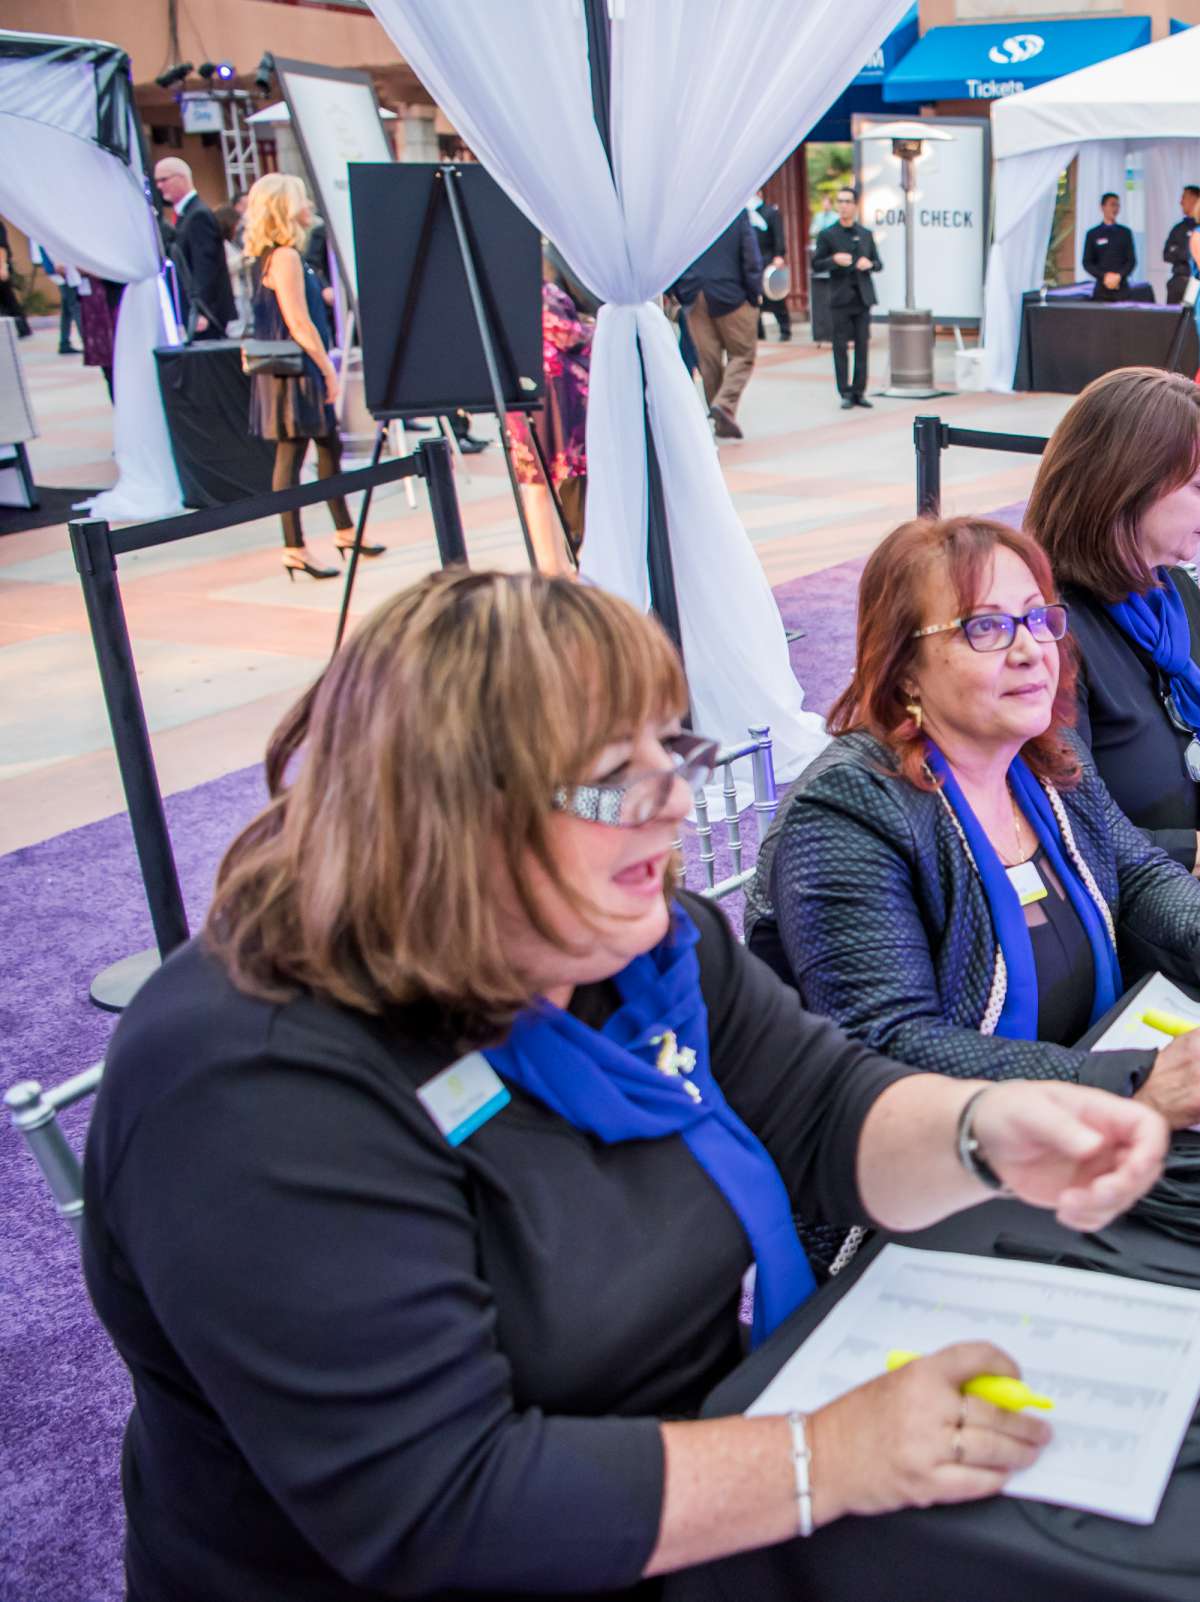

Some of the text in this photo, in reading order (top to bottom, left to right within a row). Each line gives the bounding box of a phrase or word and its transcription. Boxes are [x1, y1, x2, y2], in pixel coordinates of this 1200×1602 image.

[966, 79, 1024, 98] Tickets
[875, 208, 973, 228] COA CHECK
